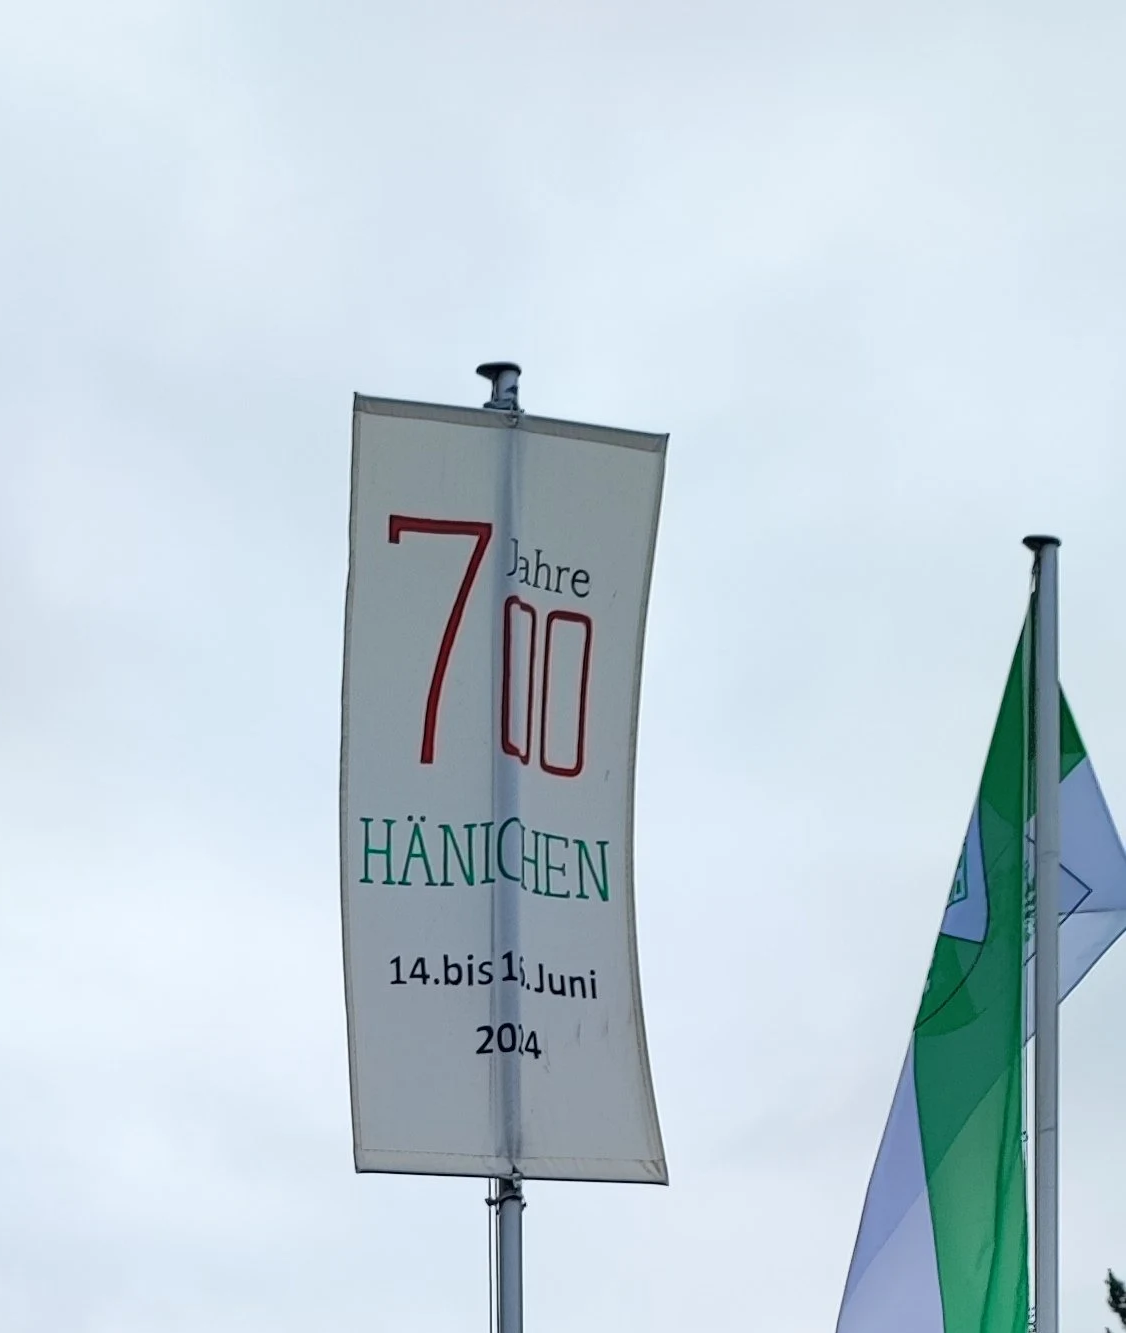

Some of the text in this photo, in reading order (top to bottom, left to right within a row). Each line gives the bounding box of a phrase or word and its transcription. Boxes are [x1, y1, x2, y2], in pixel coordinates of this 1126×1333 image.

[506, 537, 591, 598] Jahre
[359, 815, 610, 902] HÄNICHEN
[389, 953, 494, 987] 14.bis
